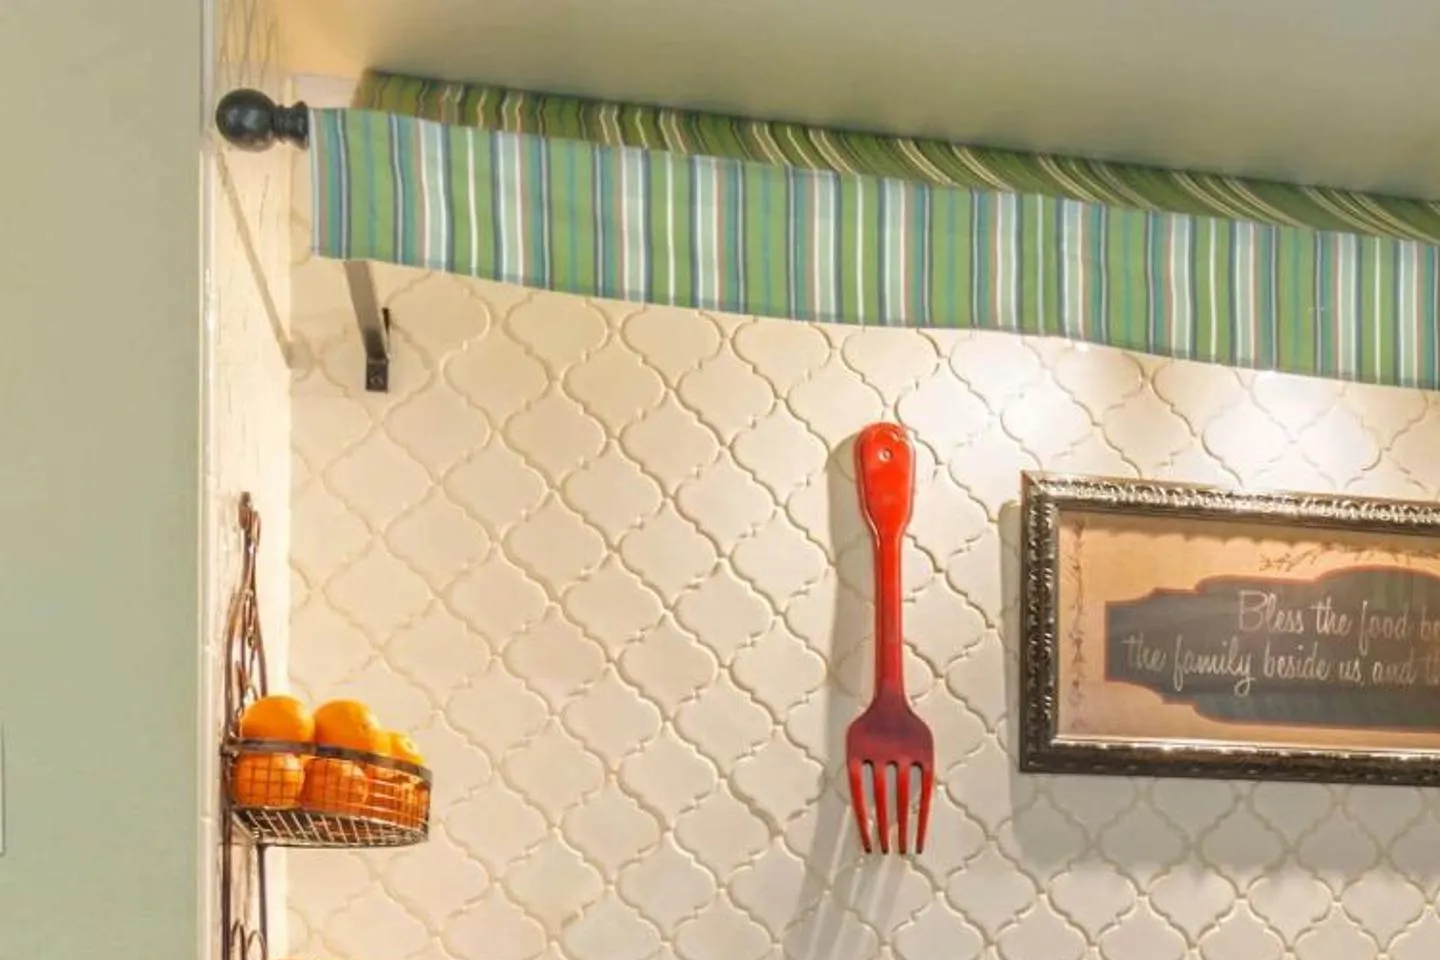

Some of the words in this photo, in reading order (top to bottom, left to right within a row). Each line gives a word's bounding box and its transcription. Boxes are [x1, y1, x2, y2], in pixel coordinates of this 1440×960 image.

[1238, 589, 1304, 635] Bless
[1311, 596, 1352, 637] the
[1359, 600, 1411, 656] food
[1123, 632, 1167, 673] the
[1173, 635, 1255, 697] family
[1263, 641, 1331, 680] beside
[1372, 647, 1417, 686] and
